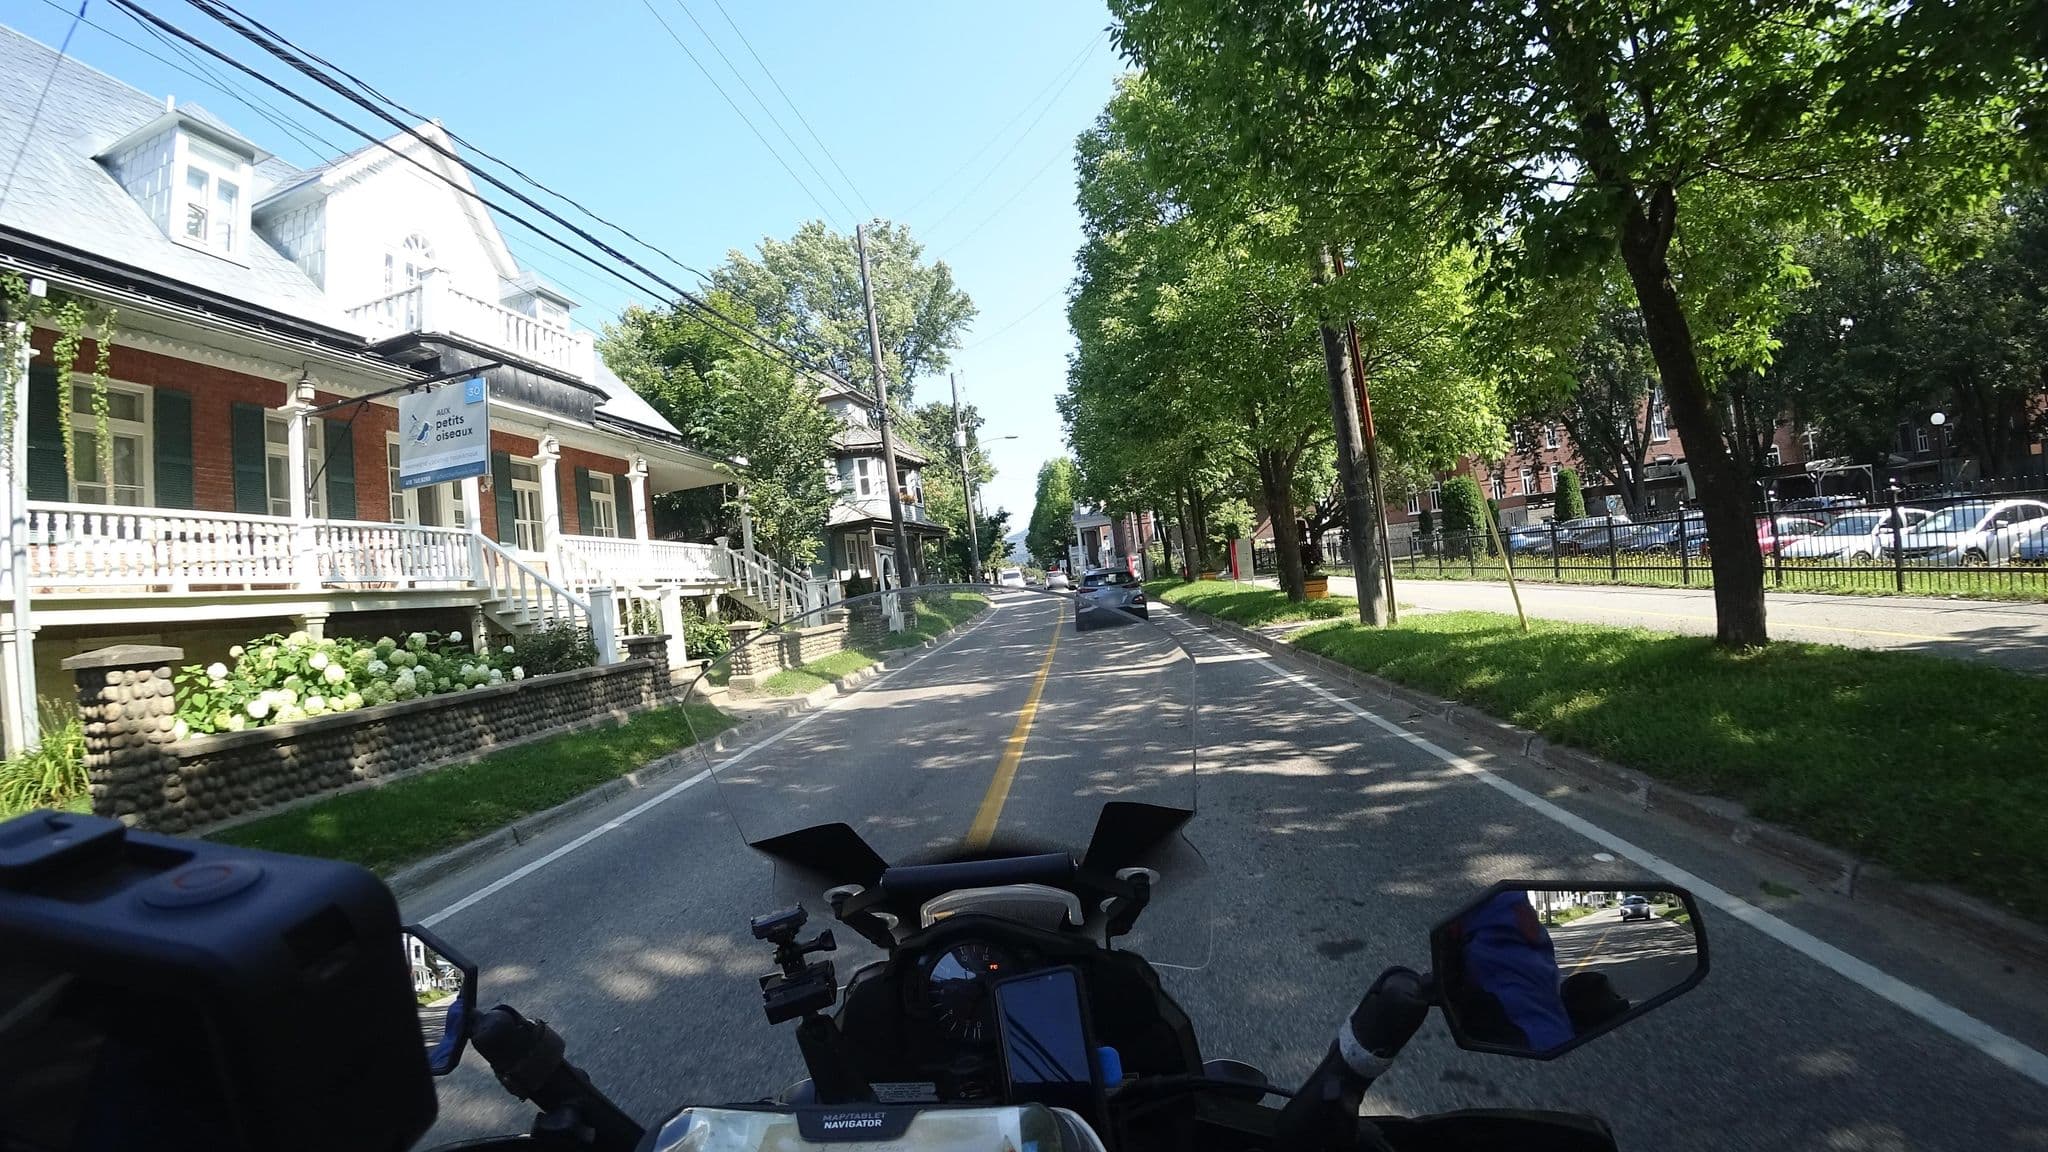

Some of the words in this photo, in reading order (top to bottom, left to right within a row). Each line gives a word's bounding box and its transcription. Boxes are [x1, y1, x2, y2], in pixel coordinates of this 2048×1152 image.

[468, 386, 481, 397] 30
[436, 407, 451, 416] AUX
[436, 414, 465, 430] petits
[436, 427, 473, 442] oiseaux
[822, 1111, 887, 1121] MAP/TABLET
[824, 1119, 882, 1129] NAVIGATOR
